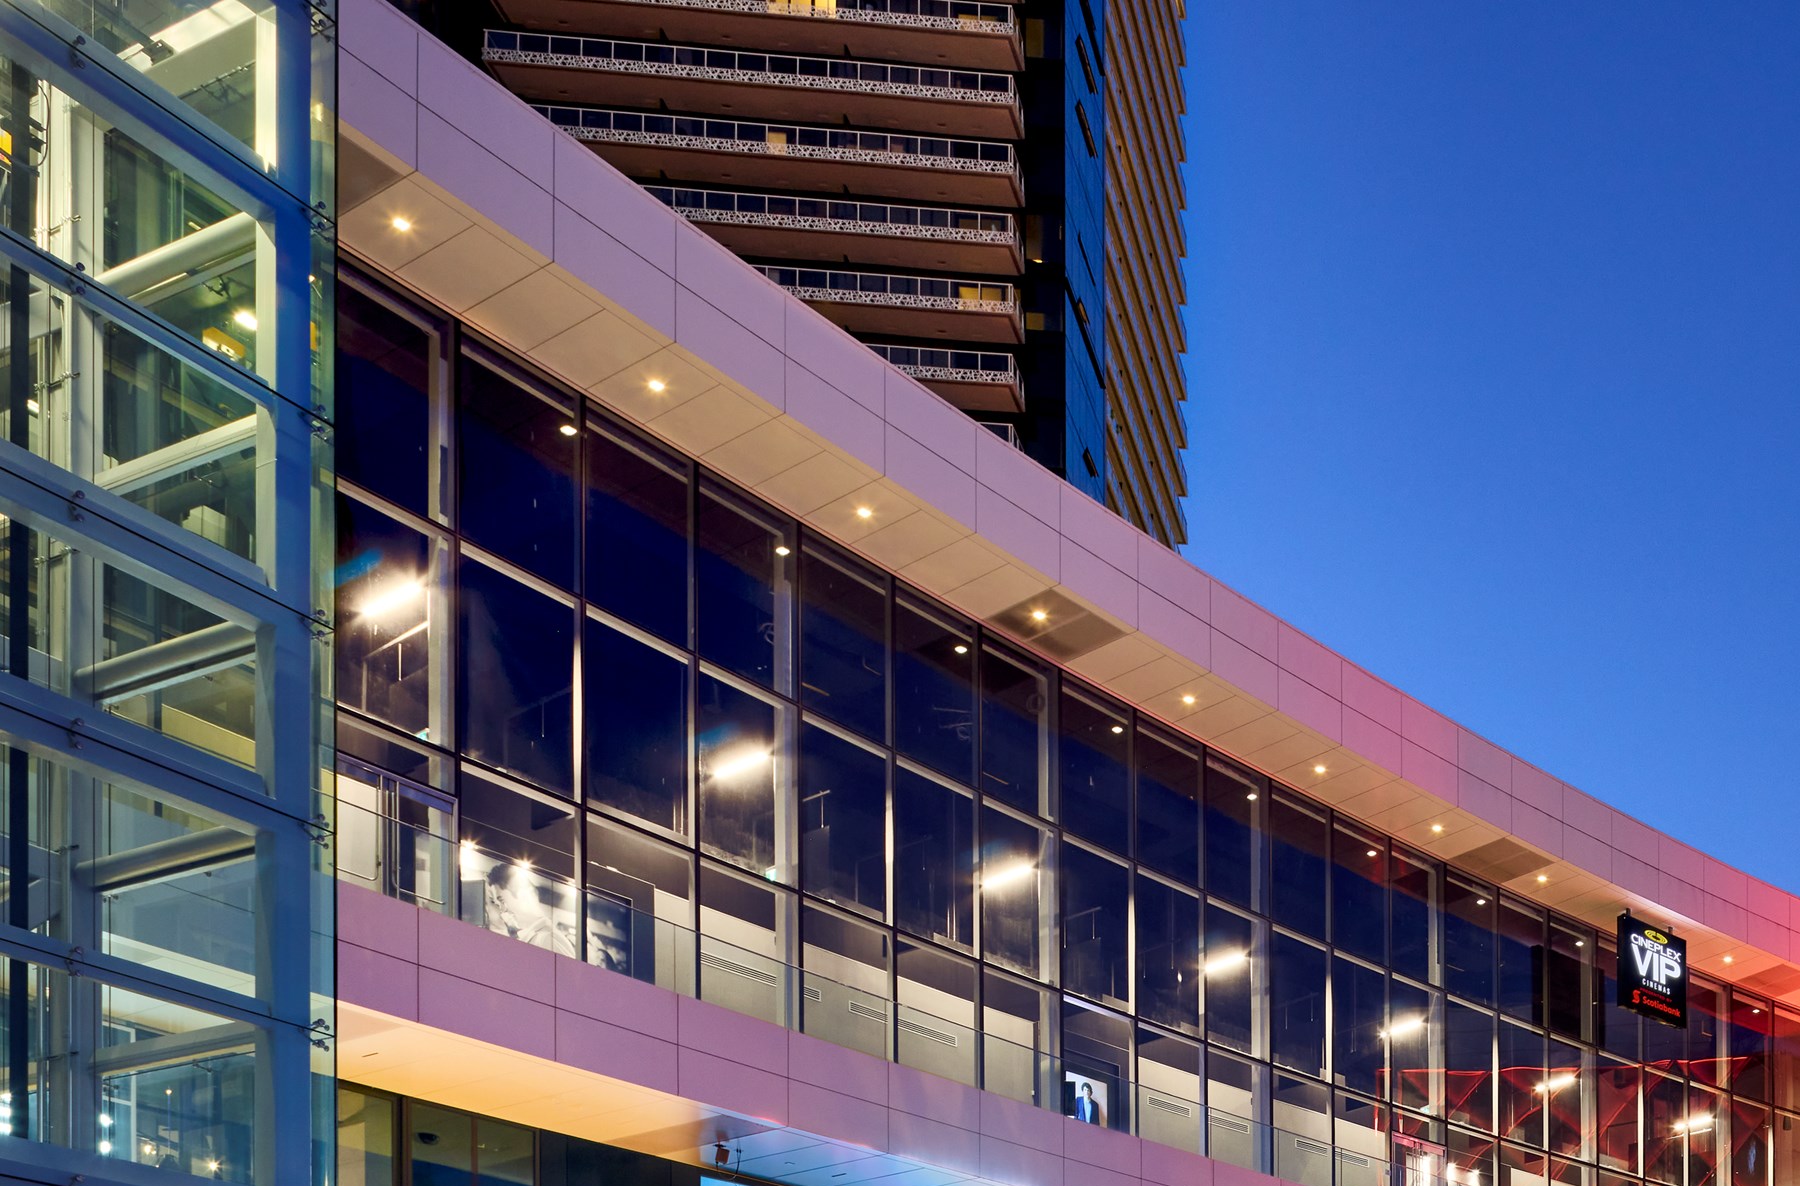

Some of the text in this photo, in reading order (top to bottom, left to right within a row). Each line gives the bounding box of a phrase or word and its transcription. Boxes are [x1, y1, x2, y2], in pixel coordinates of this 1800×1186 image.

[1630, 933, 1681, 962] CINEPLEX
[1631, 943, 1681, 985] VIP
[1641, 978, 1671, 995] CINEMAS
[1642, 996, 1681, 1017] Scotiabank
